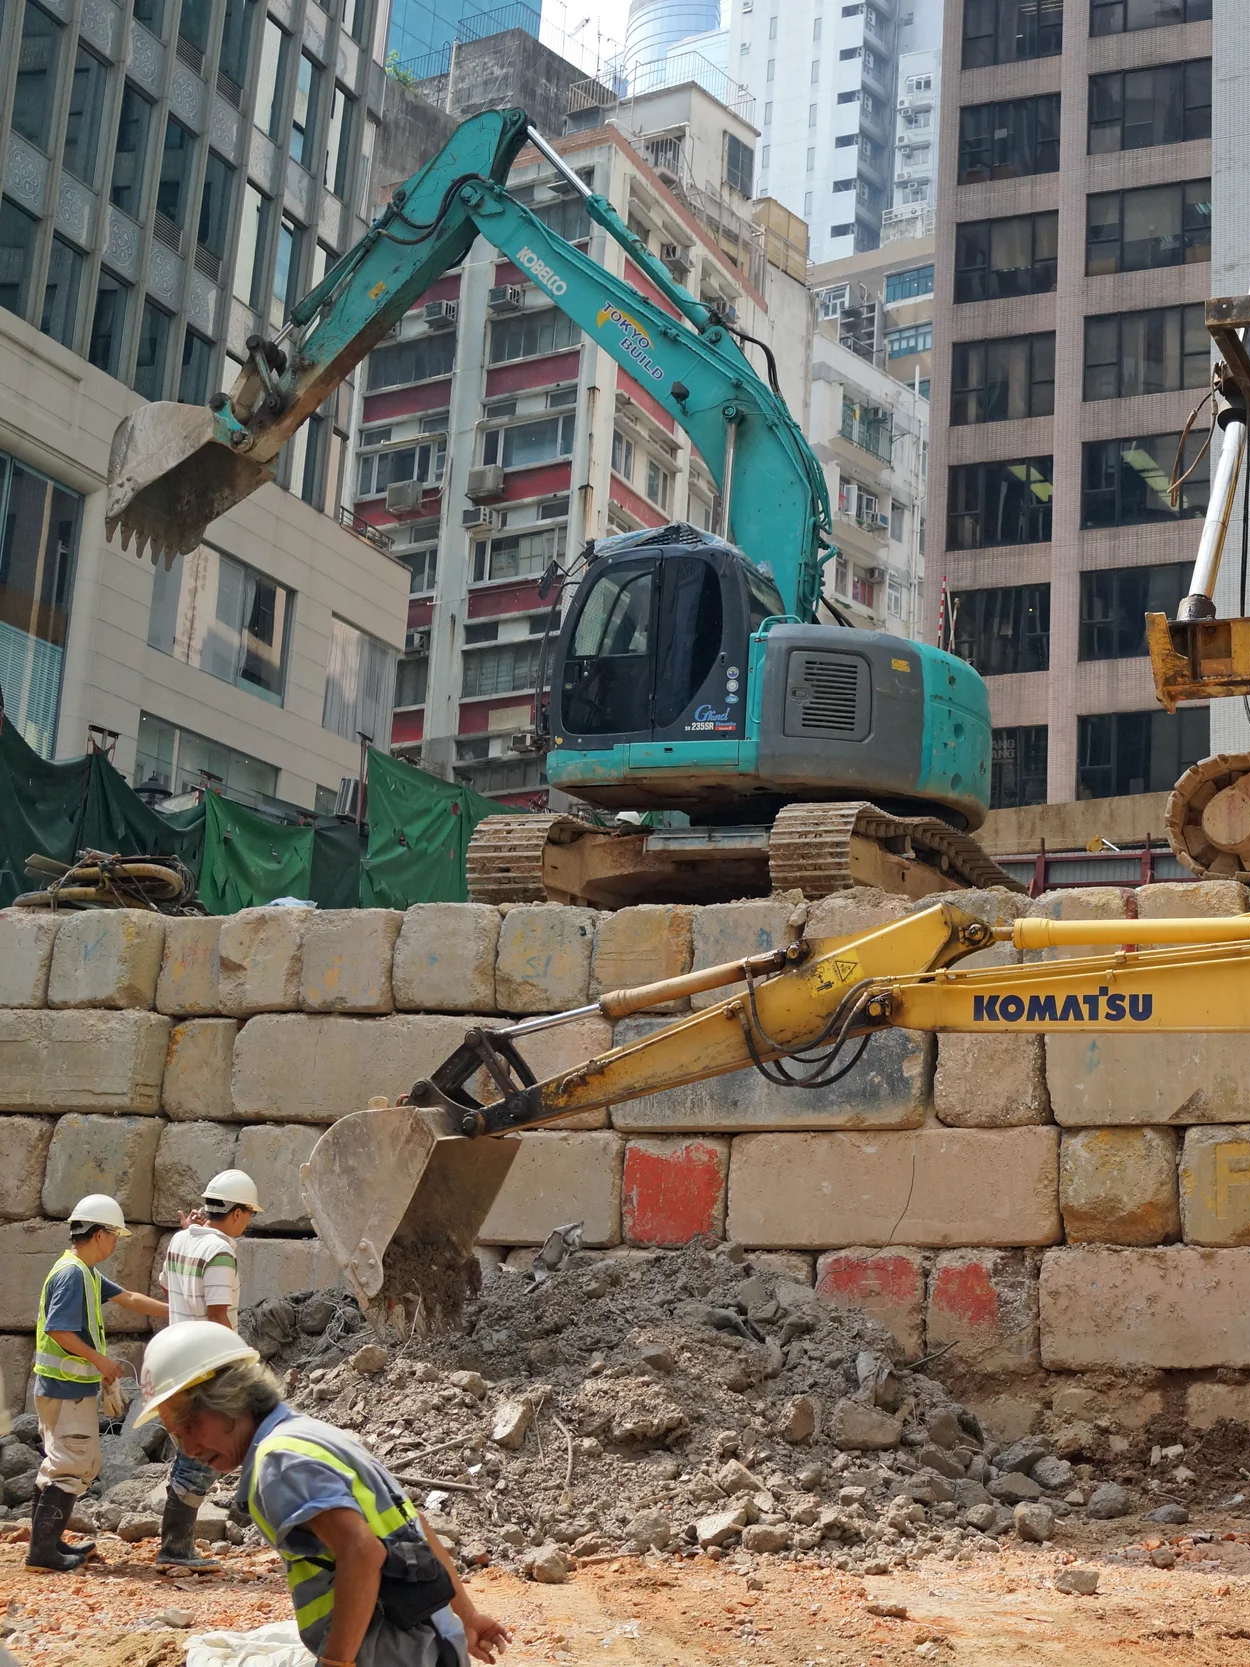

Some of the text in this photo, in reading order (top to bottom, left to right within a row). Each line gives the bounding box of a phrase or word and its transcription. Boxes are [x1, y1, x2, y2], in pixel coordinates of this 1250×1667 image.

[516, 246, 567, 296] KOBELCO
[602, 301, 650, 349] TOKYO
[619, 337, 664, 380] BUILD
[691, 722, 714, 731] 235SR
[694, 704, 731, 722] Grand
[973, 986, 1153, 1022] KOMATSU
